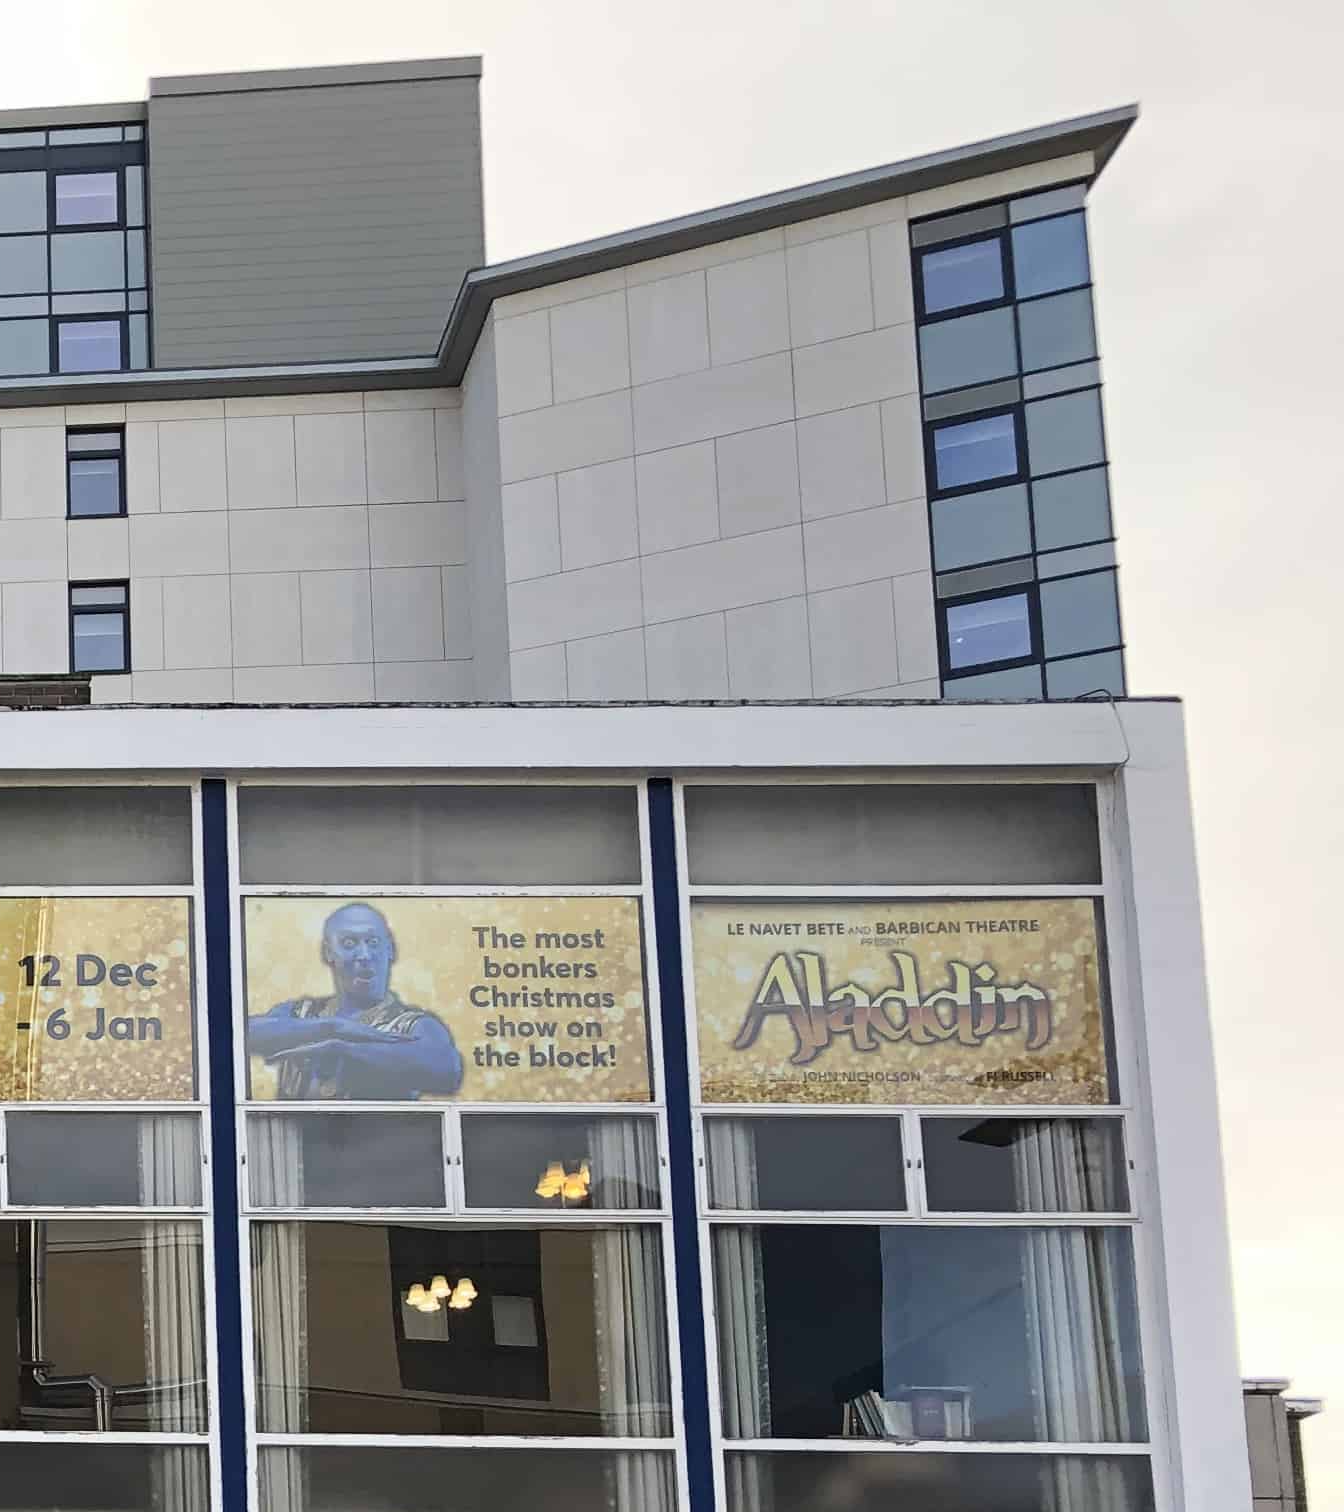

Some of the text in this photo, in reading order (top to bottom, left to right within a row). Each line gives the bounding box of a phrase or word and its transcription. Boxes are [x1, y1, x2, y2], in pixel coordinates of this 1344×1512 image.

[472, 926, 605, 949] The most
[727, 923, 745, 936] LE
[749, 922, 801, 936] NAVET
[806, 921, 845, 936] BETE
[876, 920, 960, 935] BARBICAN
[965, 919, 1041, 933] THEATRE
[17, 953, 158, 987] 12 Dec
[483, 956, 598, 979] bonkers
[469, 985, 616, 1009] Christmas
[732, 950, 1053, 1066] Aladdin
[46, 1007, 71, 1041] 6
[85, 1007, 162, 1041] Jan
[485, 1014, 603, 1038] show on
[473, 1043, 617, 1068] the block!
[802, 1071, 839, 1083] JOHN
[841, 1071, 921, 1083] NICHOLSON
